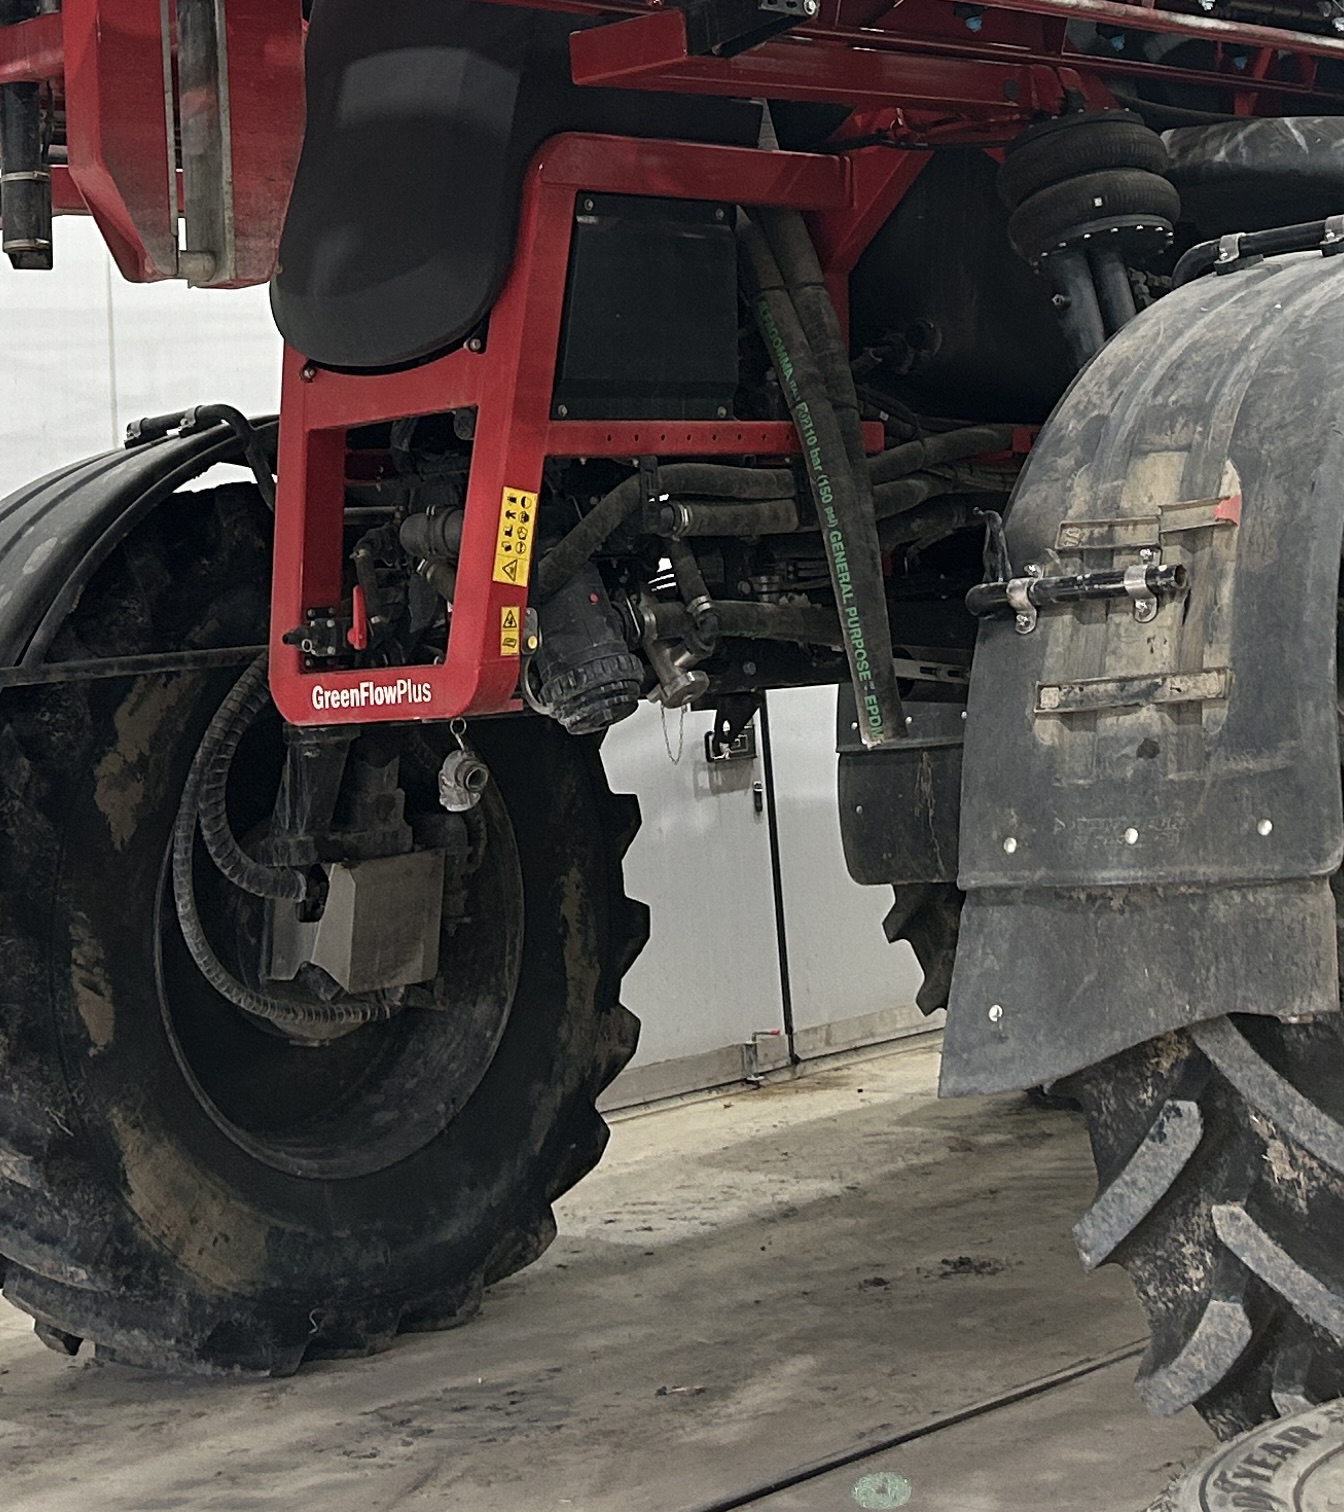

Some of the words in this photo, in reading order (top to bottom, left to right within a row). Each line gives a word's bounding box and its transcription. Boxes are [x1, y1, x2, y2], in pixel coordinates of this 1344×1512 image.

[803, 428, 818, 446] 10
[809, 447, 824, 472] bar
[816, 473, 833, 504] (150
[824, 505, 839, 528] psi)
[830, 530, 853, 603] GENERAL
[846, 606, 871, 681] PURPOSE
[312, 679, 431, 709] GreenFlowPlus
[863, 694, 884, 741] EPDM
